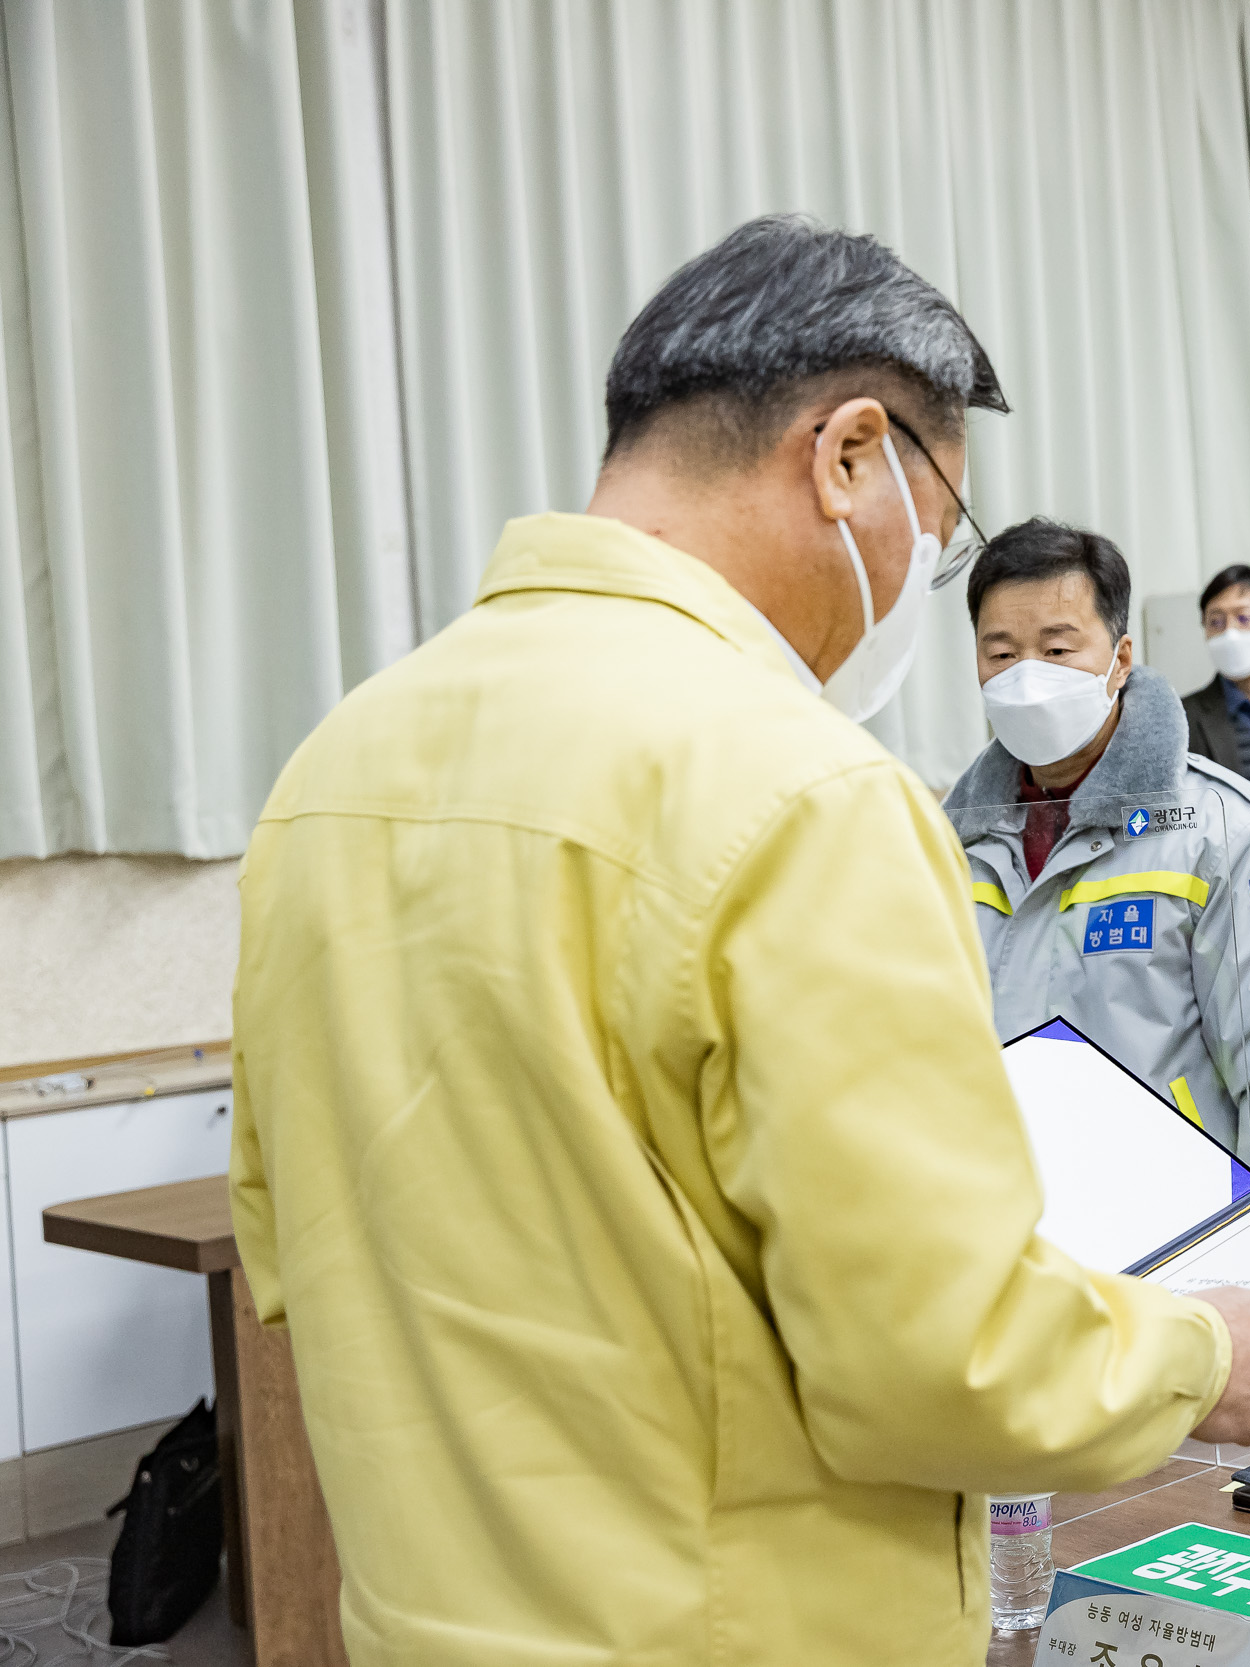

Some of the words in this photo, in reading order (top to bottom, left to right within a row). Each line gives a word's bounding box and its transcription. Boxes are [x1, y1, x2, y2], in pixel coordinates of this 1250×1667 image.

[1153, 806, 1196, 824] 광진구
[1154, 822, 1198, 833] GWANGJIN-GU
[1089, 926, 1148, 948] 방범대
[989, 1501, 1038, 1518] 아이시스
[1022, 1515, 1038, 1528] 8.0
[1087, 1602, 1112, 1624] 능동
[1118, 1610, 1144, 1632] 여성
[1148, 1618, 1217, 1653] 자율방범대
[1048, 1637, 1078, 1657] 부대장
